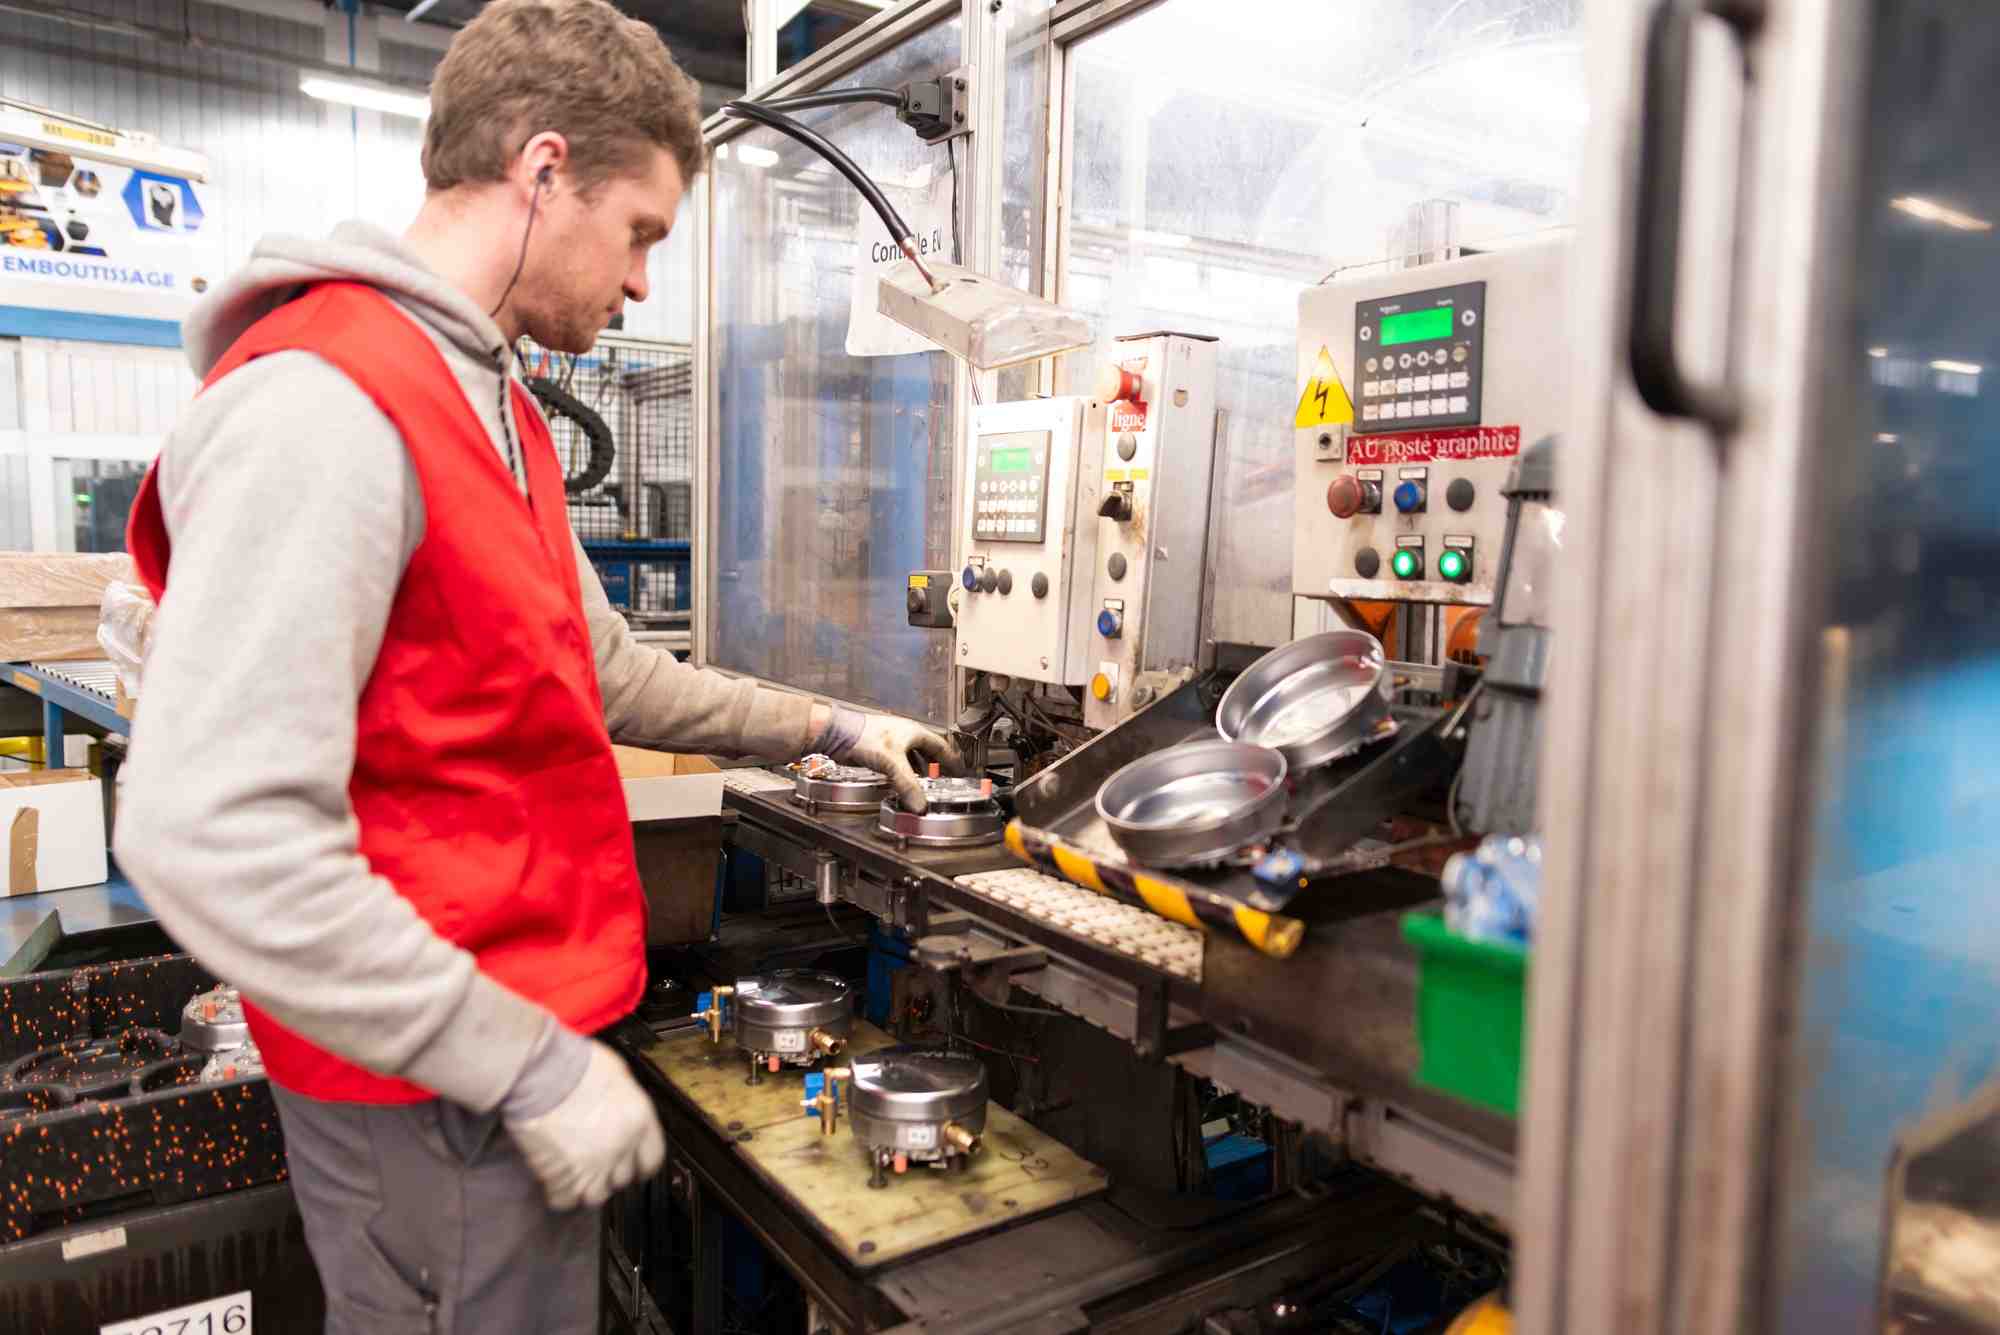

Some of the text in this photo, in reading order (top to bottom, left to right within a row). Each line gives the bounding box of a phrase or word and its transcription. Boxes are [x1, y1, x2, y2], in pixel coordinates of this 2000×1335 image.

[872, 232, 928, 263] Conle
[2, 255, 176, 288] EMBOUTISSAGE
[1113, 411, 1146, 432] ligne
[1350, 438, 1378, 459] AU
[1434, 429, 1517, 459] graphite
[118, 1304, 247, 1335] 716
